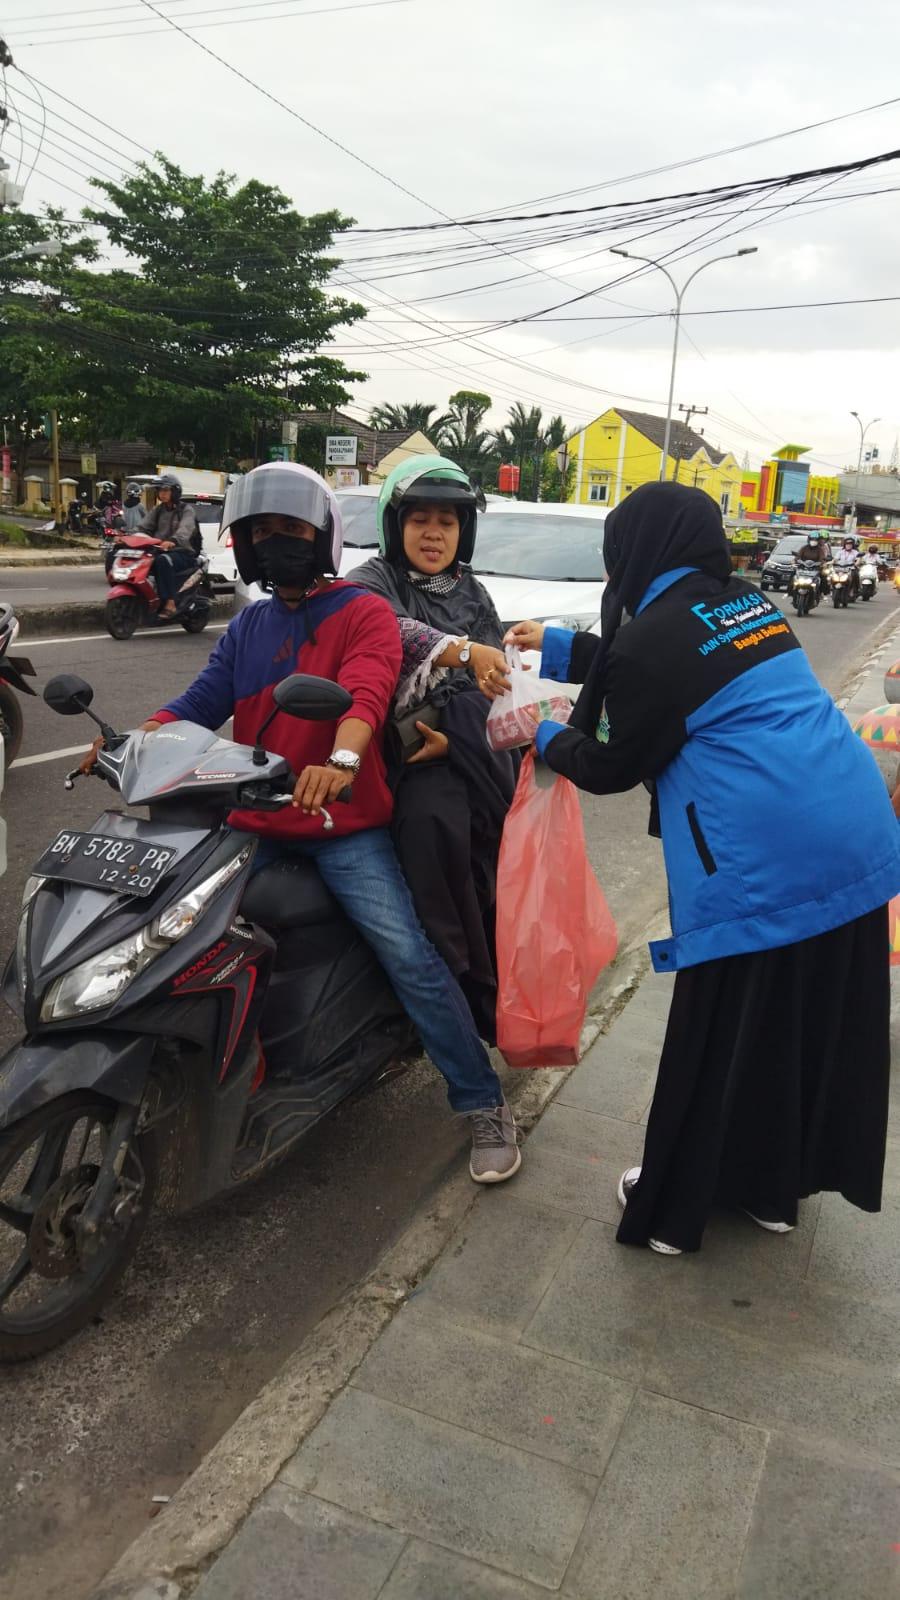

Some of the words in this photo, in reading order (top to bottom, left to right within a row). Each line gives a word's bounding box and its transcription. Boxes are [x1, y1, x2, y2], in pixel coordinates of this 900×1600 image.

[690, 592, 764, 631] FORMASI
[698, 637, 721, 656] IAIN
[732, 632, 765, 650] Bangka
[51, 834, 81, 854] BN
[83, 837, 135, 864] 5782
[138, 848, 171, 871] PR
[229, 924, 253, 940] HONDA
[174, 940, 229, 987] HONDA
